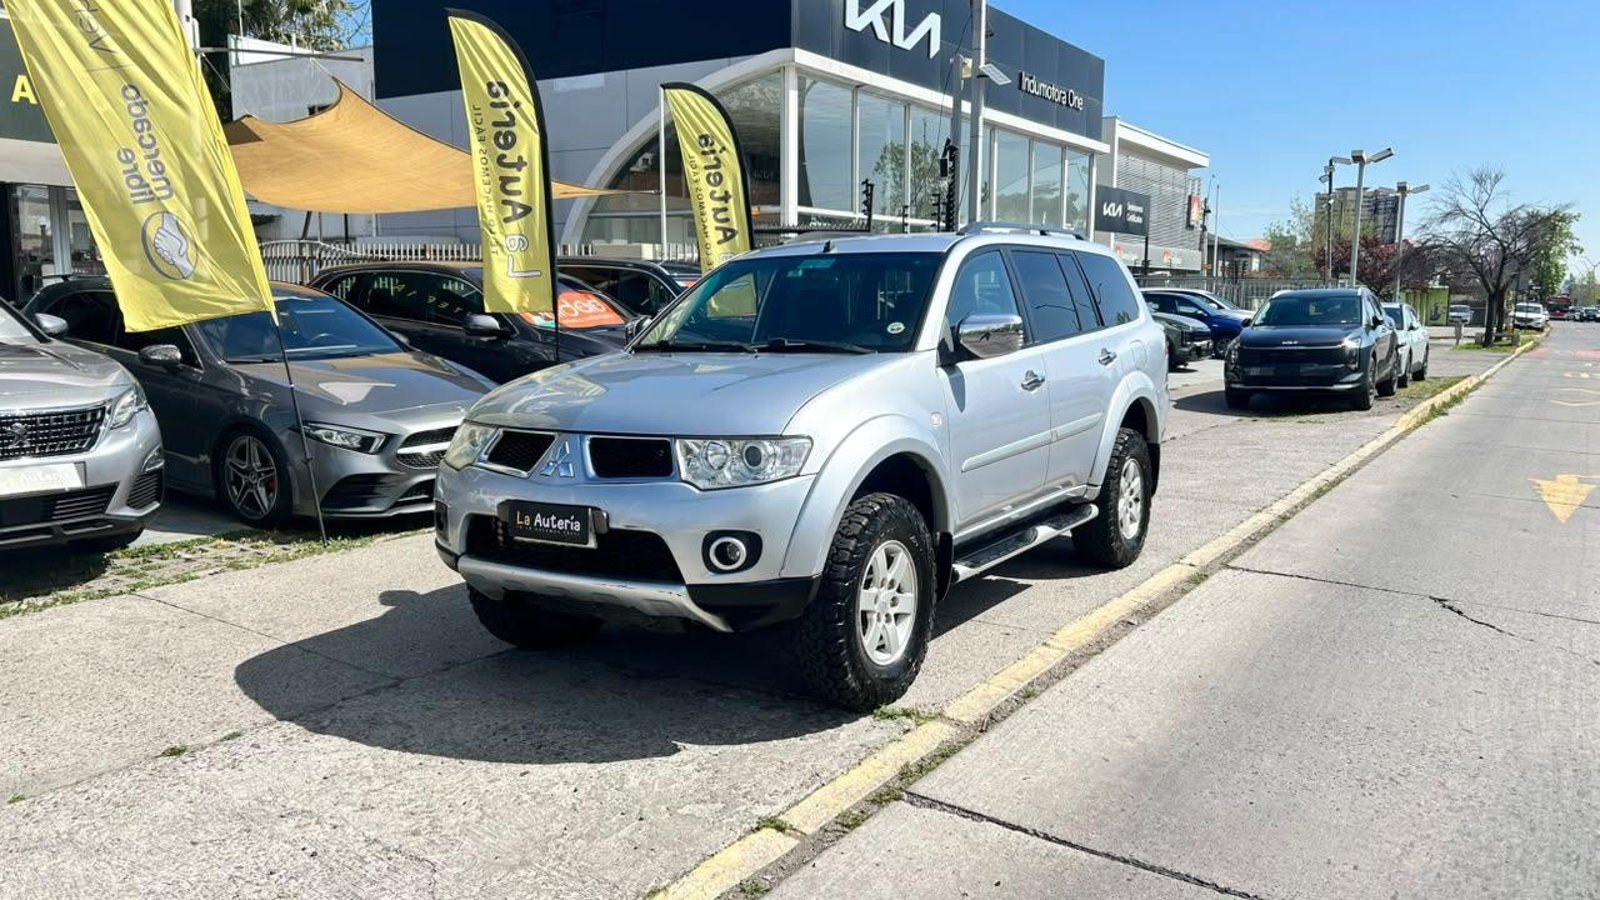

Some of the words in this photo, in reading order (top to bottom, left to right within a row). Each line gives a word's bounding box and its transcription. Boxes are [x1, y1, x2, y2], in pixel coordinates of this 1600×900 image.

[845, 0, 941, 59] KIA
[1021, 71, 1067, 105] Indumotora
[1068, 89, 1084, 111] One
[1103, 201, 1123, 217] KIA
[516, 511, 531, 526] La
[534, 513, 581, 532] Autería
